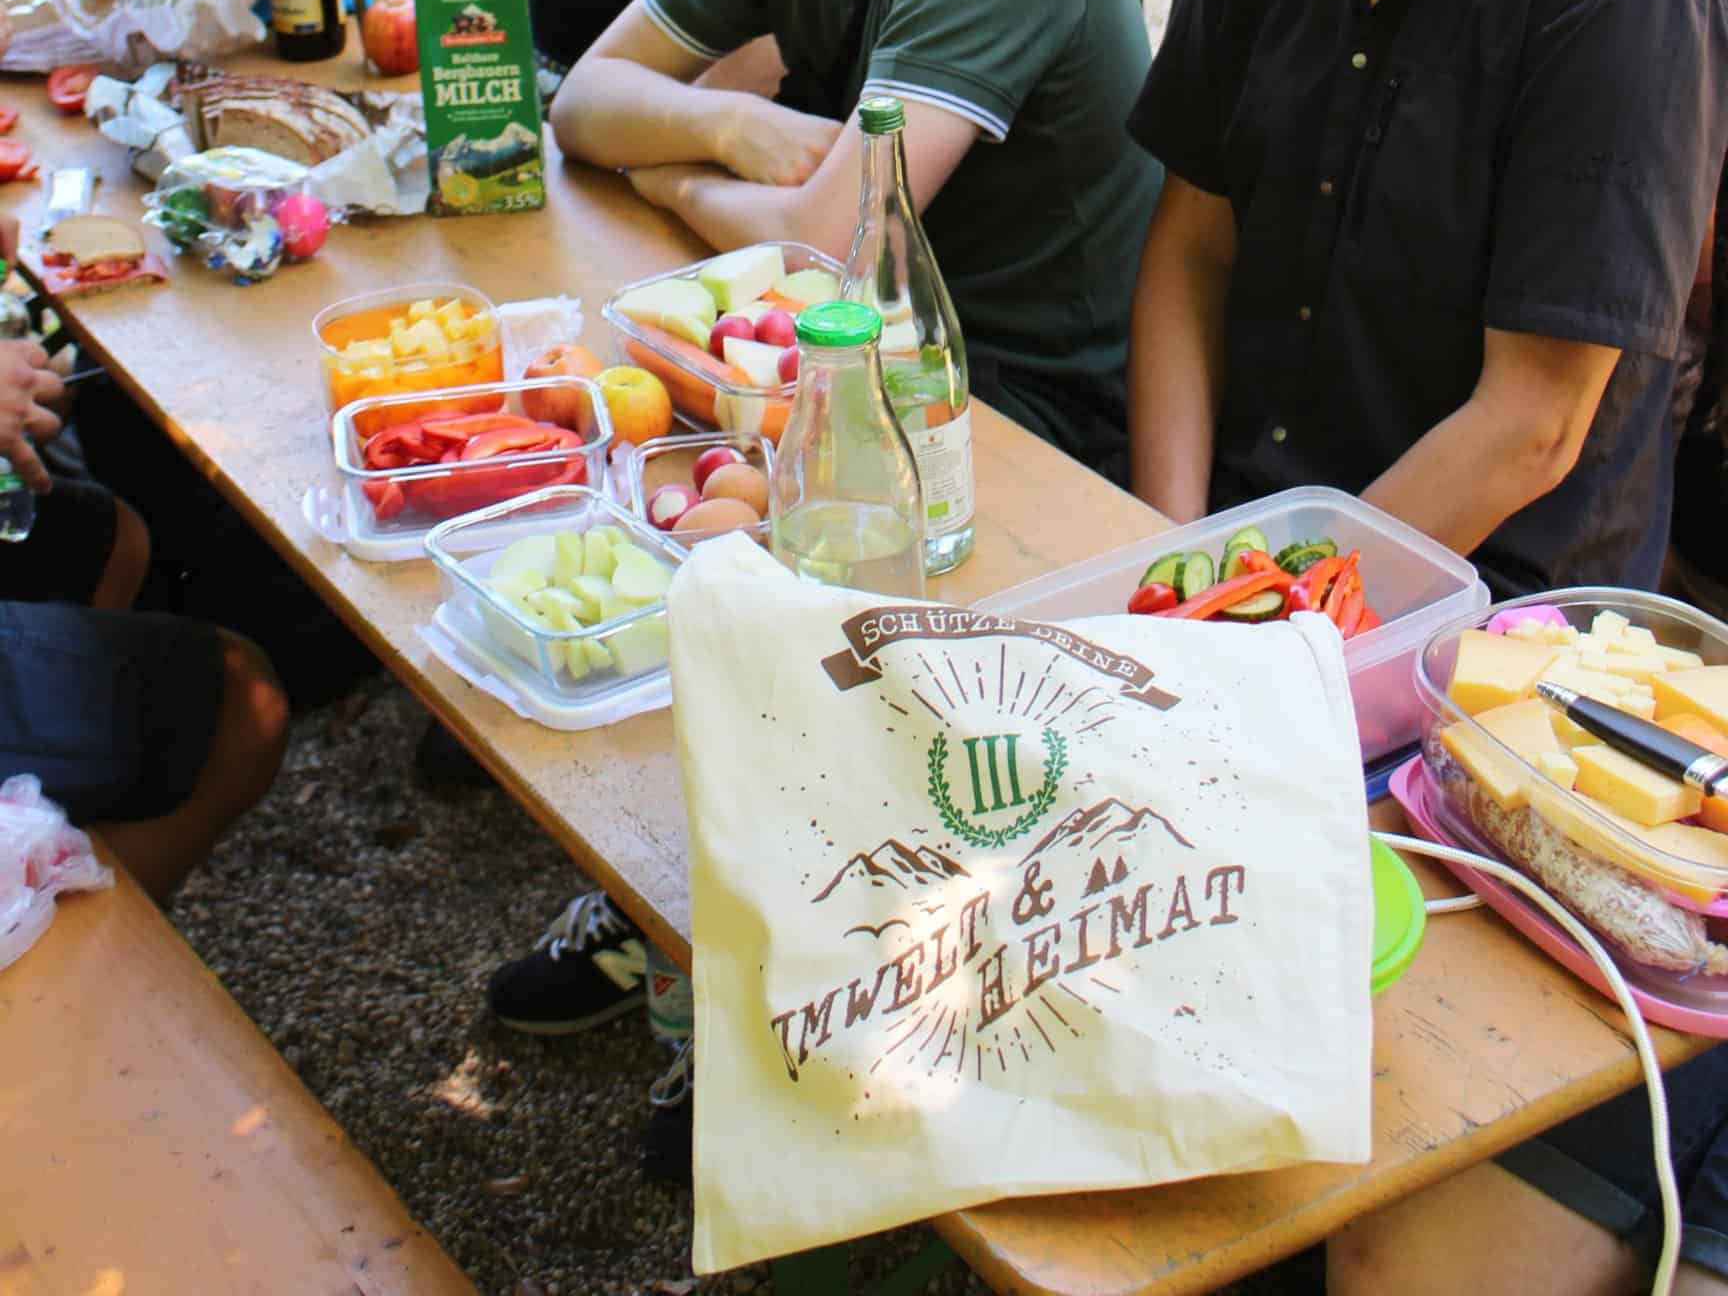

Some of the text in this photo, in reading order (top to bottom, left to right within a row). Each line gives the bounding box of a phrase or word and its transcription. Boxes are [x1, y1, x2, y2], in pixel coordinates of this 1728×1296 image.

[434, 77, 523, 108] MILCH
[861, 609, 1015, 646] SCHÜTZE
[1012, 860, 1055, 925] &
[975, 864, 1246, 1033] HEIMAT
